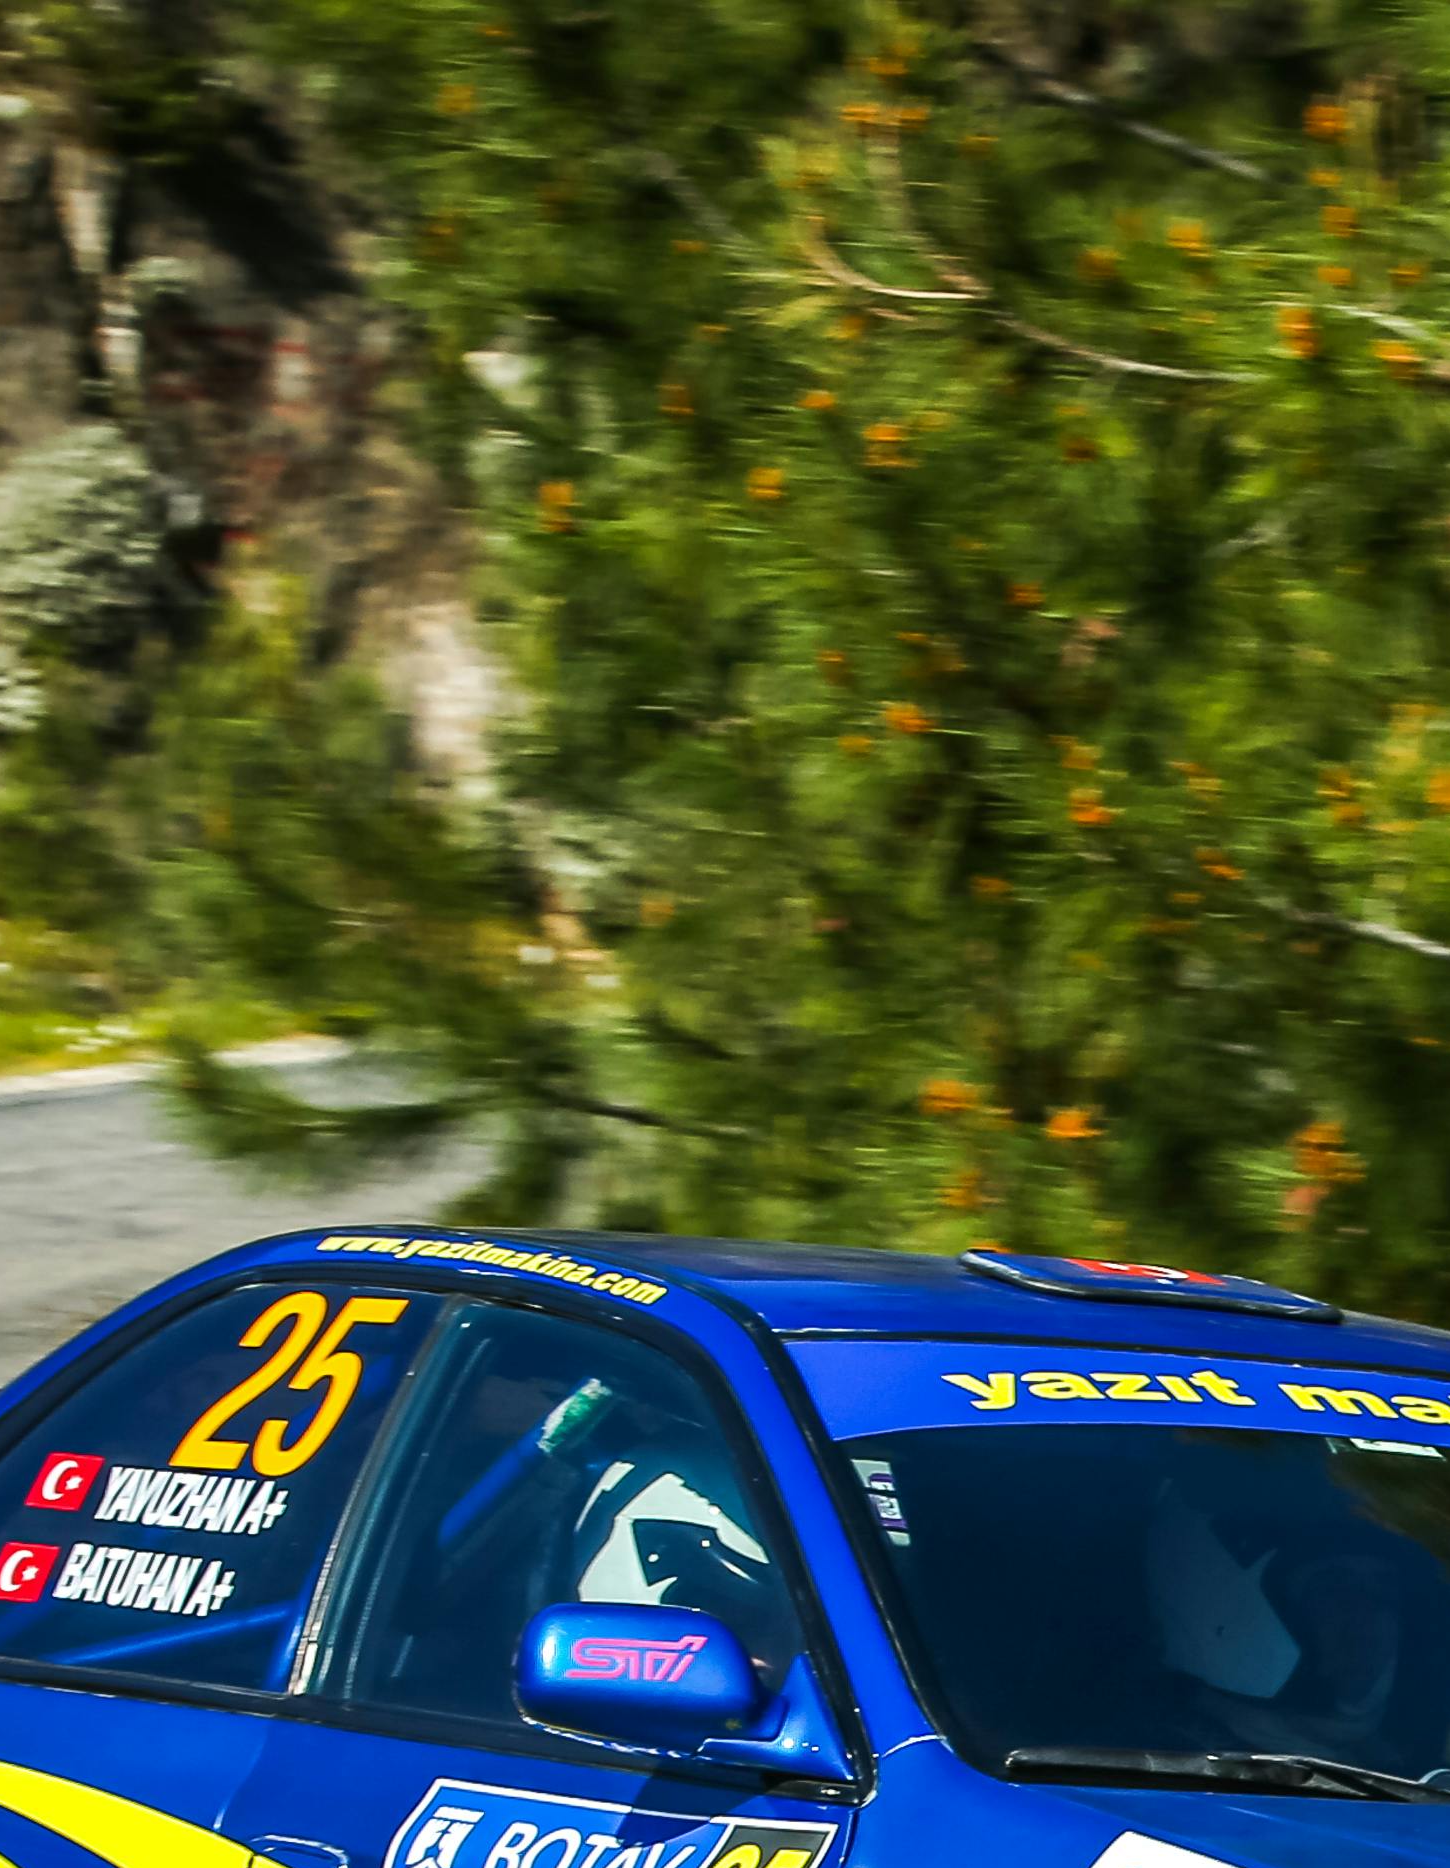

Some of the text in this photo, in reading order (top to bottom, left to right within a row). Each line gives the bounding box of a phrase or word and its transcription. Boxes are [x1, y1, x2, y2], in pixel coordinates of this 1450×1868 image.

[316, 1236, 668, 1305] www.yazitmakina.com
[168, 1291, 410, 1477] 25
[94, 1466, 257, 1534] YAVUZHAN
[52, 1543, 203, 1614] BATUHAN
